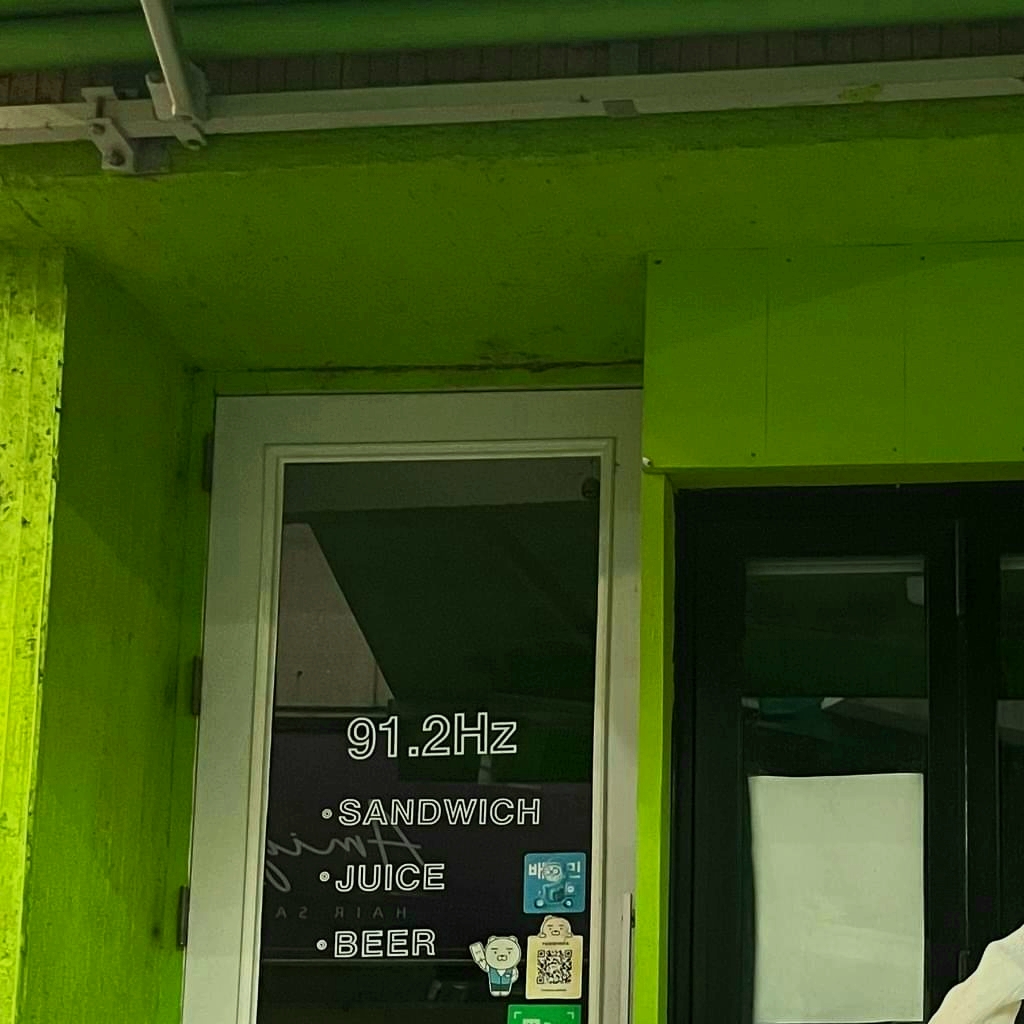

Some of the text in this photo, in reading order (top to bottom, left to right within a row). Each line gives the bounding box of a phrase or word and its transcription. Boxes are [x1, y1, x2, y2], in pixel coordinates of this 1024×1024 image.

[347, 712, 518, 761] 91.2Hz
[339, 799, 541, 826] SANDWICH
[335, 863, 445, 892] JUICE
[334, 929, 436, 958] BEER
